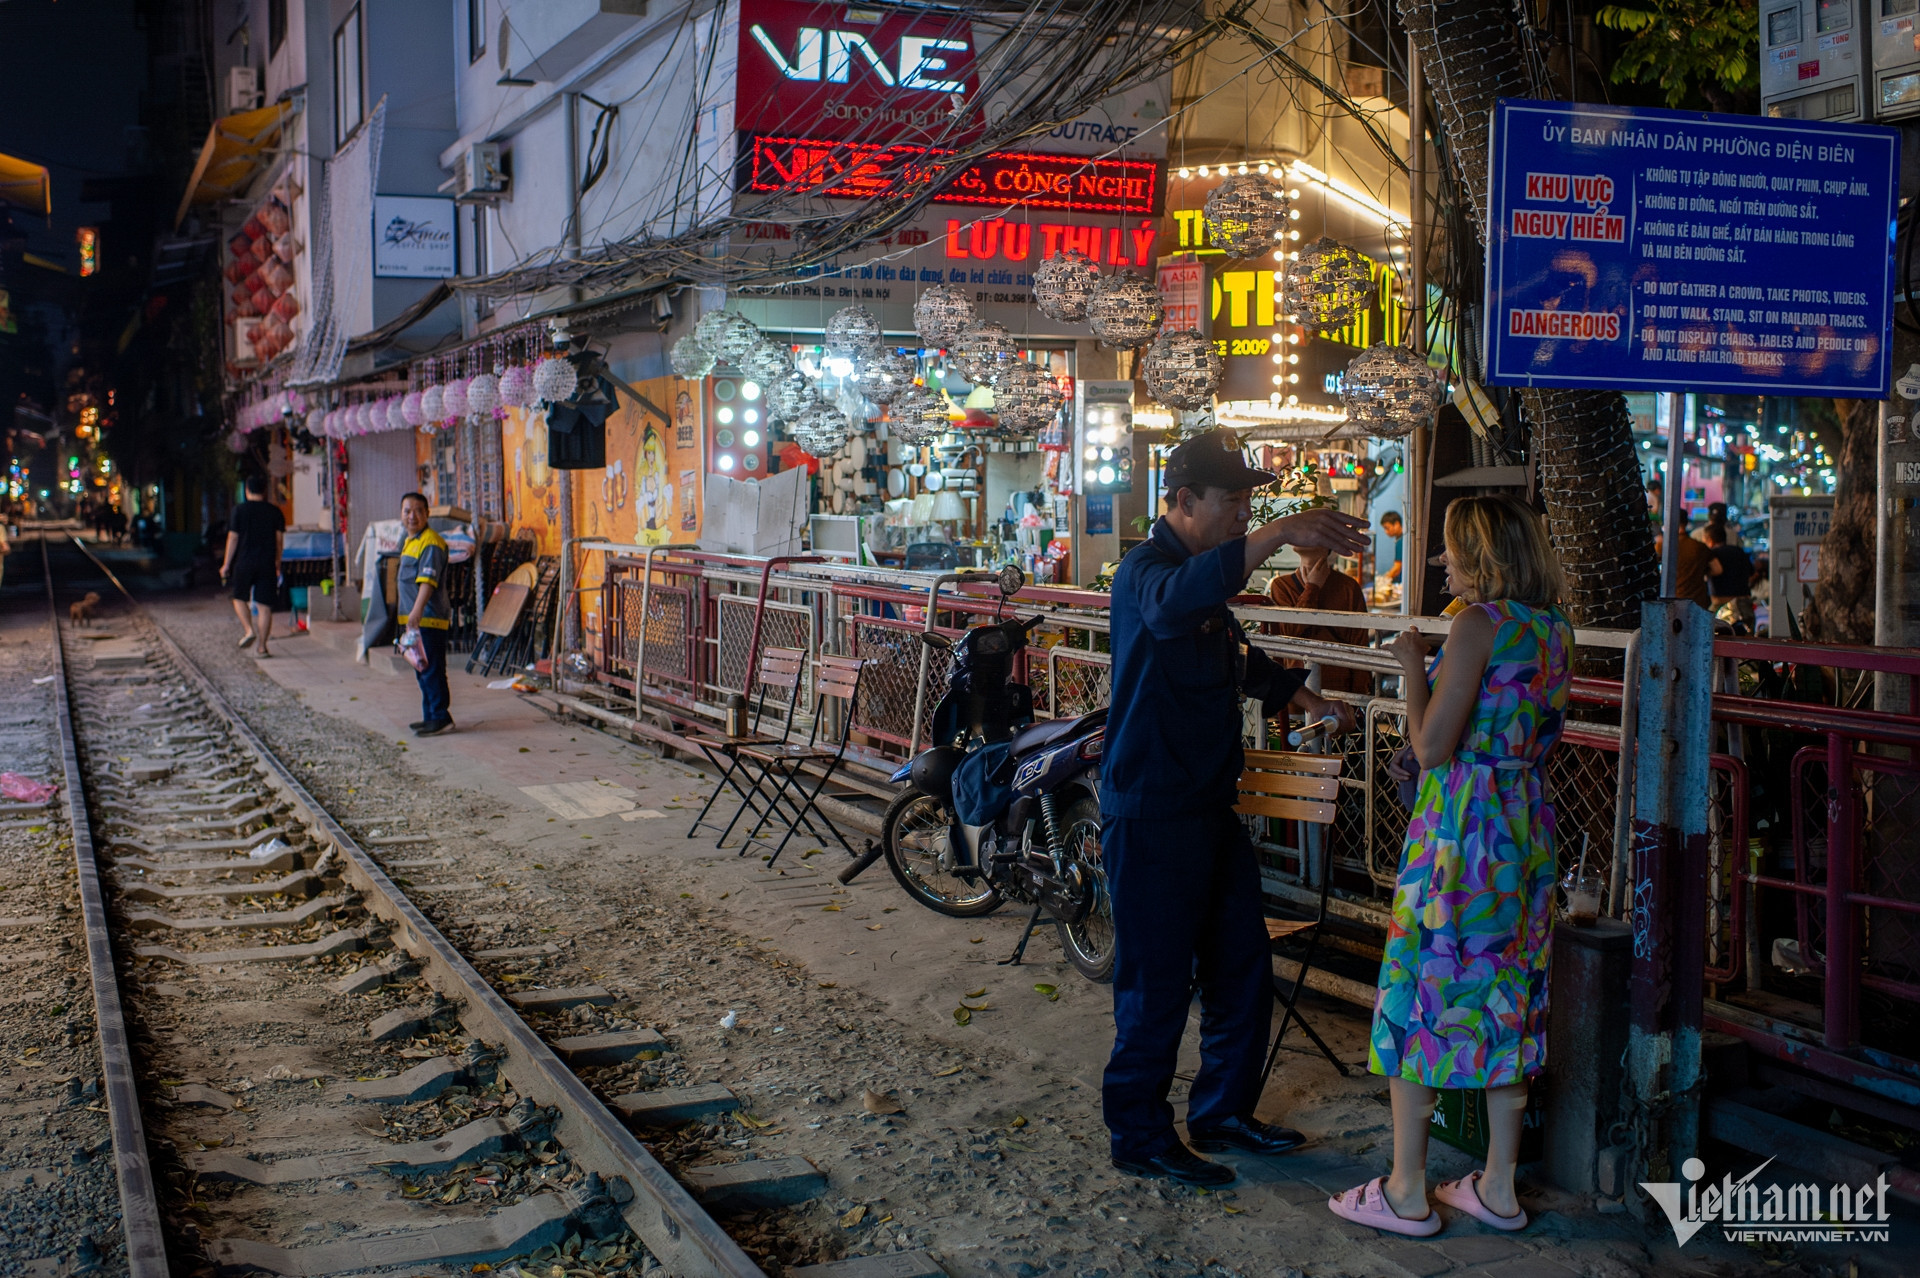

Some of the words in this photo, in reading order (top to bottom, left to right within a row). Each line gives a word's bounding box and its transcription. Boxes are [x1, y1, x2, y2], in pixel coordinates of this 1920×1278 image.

[1543, 120, 1566, 142] ỦY
[1570, 128, 1606, 146] BAN
[1611, 128, 1658, 150] NHÂN
[1663, 131, 1697, 152] DÂN
[1702, 136, 1771, 157] PHƯỜNG
[1775, 140, 1813, 163] ĐIỆN
[1818, 143, 1855, 163] BIÊN
[1527, 173, 1569, 200] KHU
[1573, 175, 1613, 207] VỰC
[1646, 166, 1678, 183] KHÔNG
[1680, 170, 1691, 187] TỤ
[1693, 169, 1710, 188] TẬP
[1771, 177, 1794, 192] QUAY
[1796, 179, 1822, 195] PHIM,
[1823, 180, 1847, 198] CHỤP
[1645, 193, 1676, 210] KHÔNG
[1744, 200, 1766, 216] TRÊN
[1513, 211, 1568, 238] NGUY
[1572, 207, 1624, 241] HIỂM
[1643, 220, 1675, 237] KHÔNG
[1801, 231, 1829, 246] TRONG
[946, 217, 1031, 261] LƯU
[1107, 220, 1156, 267] LÝ
[1656, 244, 1672, 259] HAI
[1674, 243, 1692, 260] BÊN
[1171, 270, 1198, 282] ASIA
[1643, 281, 1657, 295] DO
[1659, 282, 1679, 296] NOT
[1680, 283, 1717, 298] GATHER
[1719, 285, 1726, 298] A
[1729, 286, 1765, 302] CROWD,
[1767, 288, 1790, 302] TAKE
[1792, 289, 1831, 305] PHOTOS,
[1833, 291, 1869, 306] VIDEOS.
[1510, 310, 1618, 340] DANGEROUS
[1643, 305, 1657, 318] DO
[1659, 305, 1678, 319] NOT
[1680, 306, 1711, 322] WALK,
[1712, 308, 1746, 324] STAND,
[1748, 309, 1764, 323] SIT
[1765, 310, 1779, 324] ON
[1781, 312, 1827, 326] RAILROAD
[1829, 314, 1868, 328] TRACKS.
[1231, 339, 1270, 356] 2009
[1641, 329, 1655, 342] DO
[1657, 330, 1676, 343] NOT
[1678, 330, 1718, 345] DISPLAY
[1720, 333, 1757, 348] CHAIRS,
[1759, 334, 1794, 349] TABLES
[1795, 336, 1815, 349] AND
[1817, 337, 1852, 351] PEDDLE
[1854, 339, 1868, 352] ON
[1642, 348, 1663, 361] AND
[1665, 349, 1697, 363] ALONG
[1699, 350, 1744, 365] RAILROAD
[1746, 352, 1786, 367] TRACKS.
